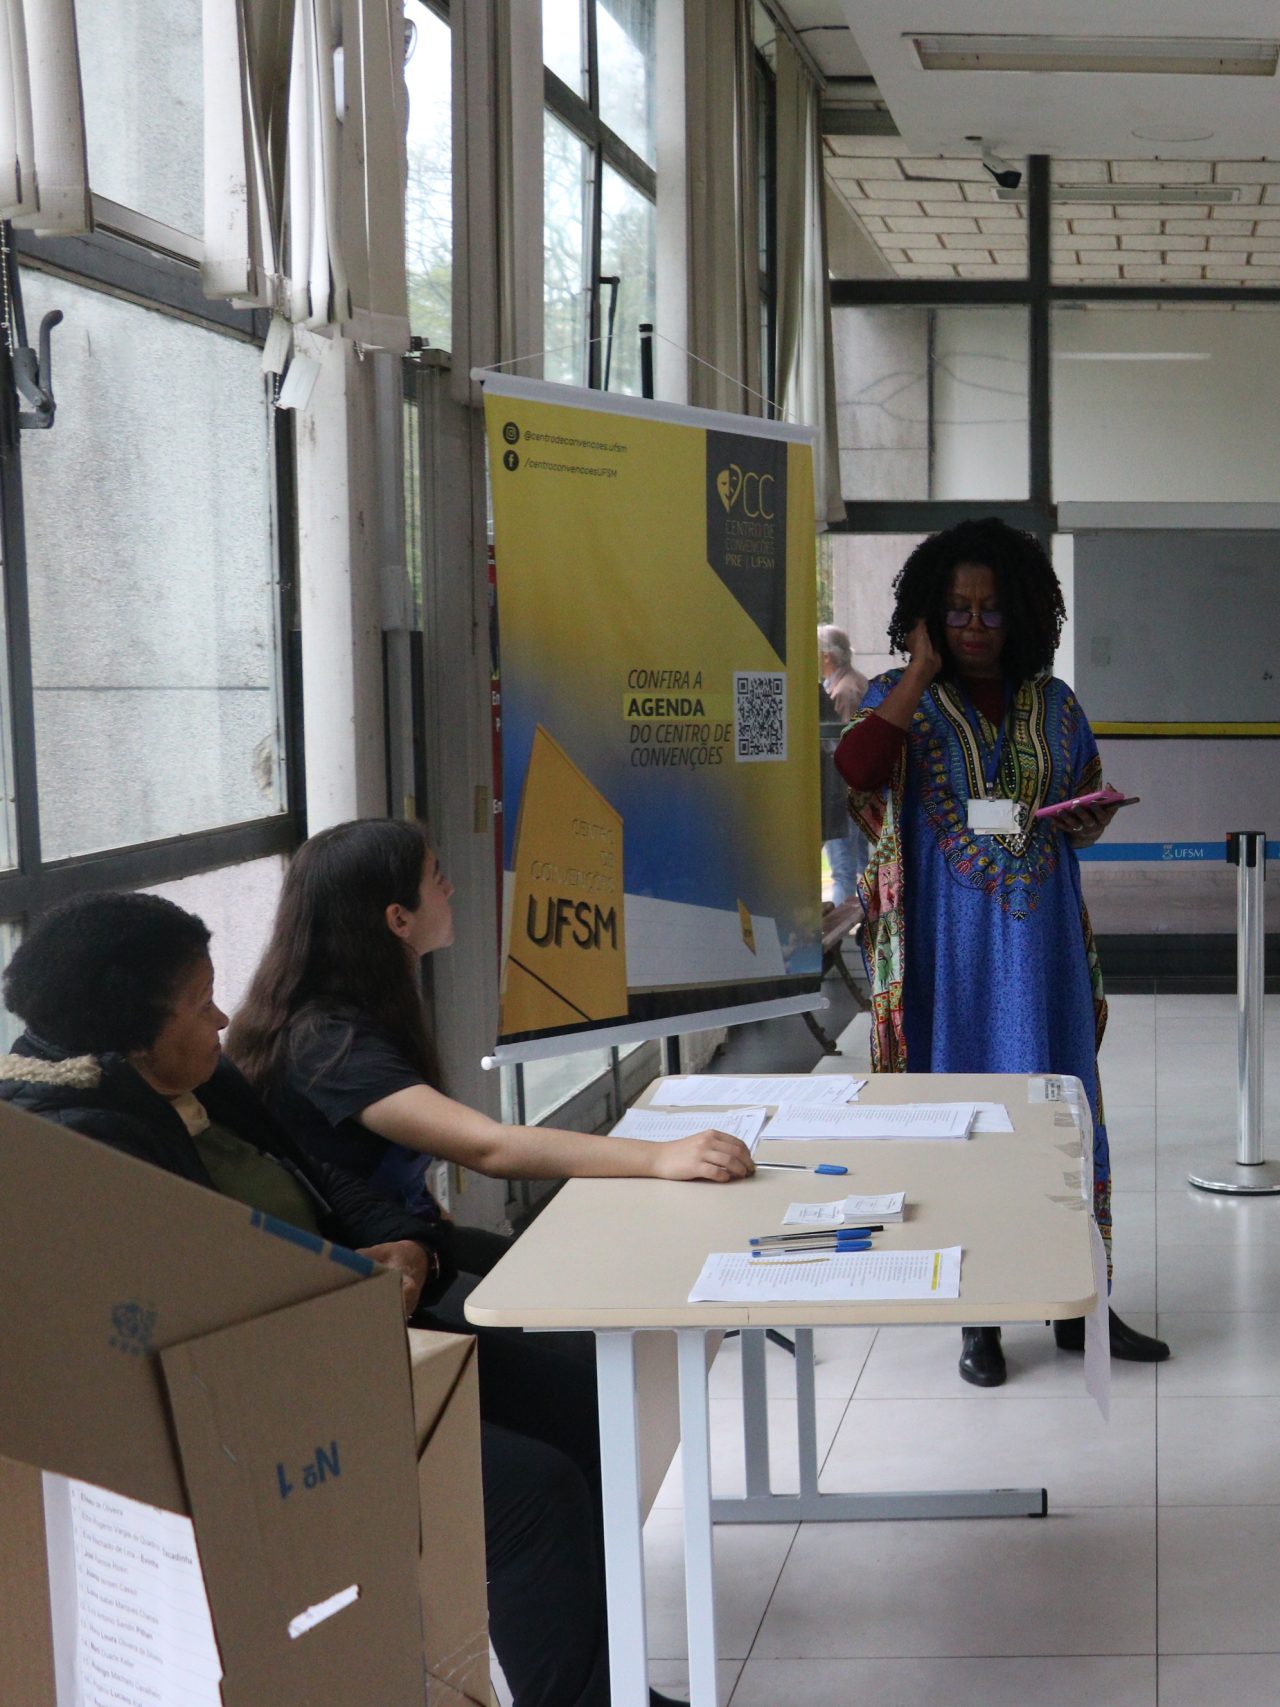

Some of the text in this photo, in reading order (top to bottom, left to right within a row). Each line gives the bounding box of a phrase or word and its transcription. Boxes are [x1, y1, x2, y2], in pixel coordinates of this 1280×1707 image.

[743, 472, 775, 519] CC
[628, 669, 703, 689] CONFIRA A
[628, 698, 705, 717] AGENDA
[629, 724, 733, 744] DO CENTRO DE
[631, 743, 723, 771] CONVENÇÕES
[1174, 848, 1204, 858] UFSM
[527, 894, 618, 951] UFSM
